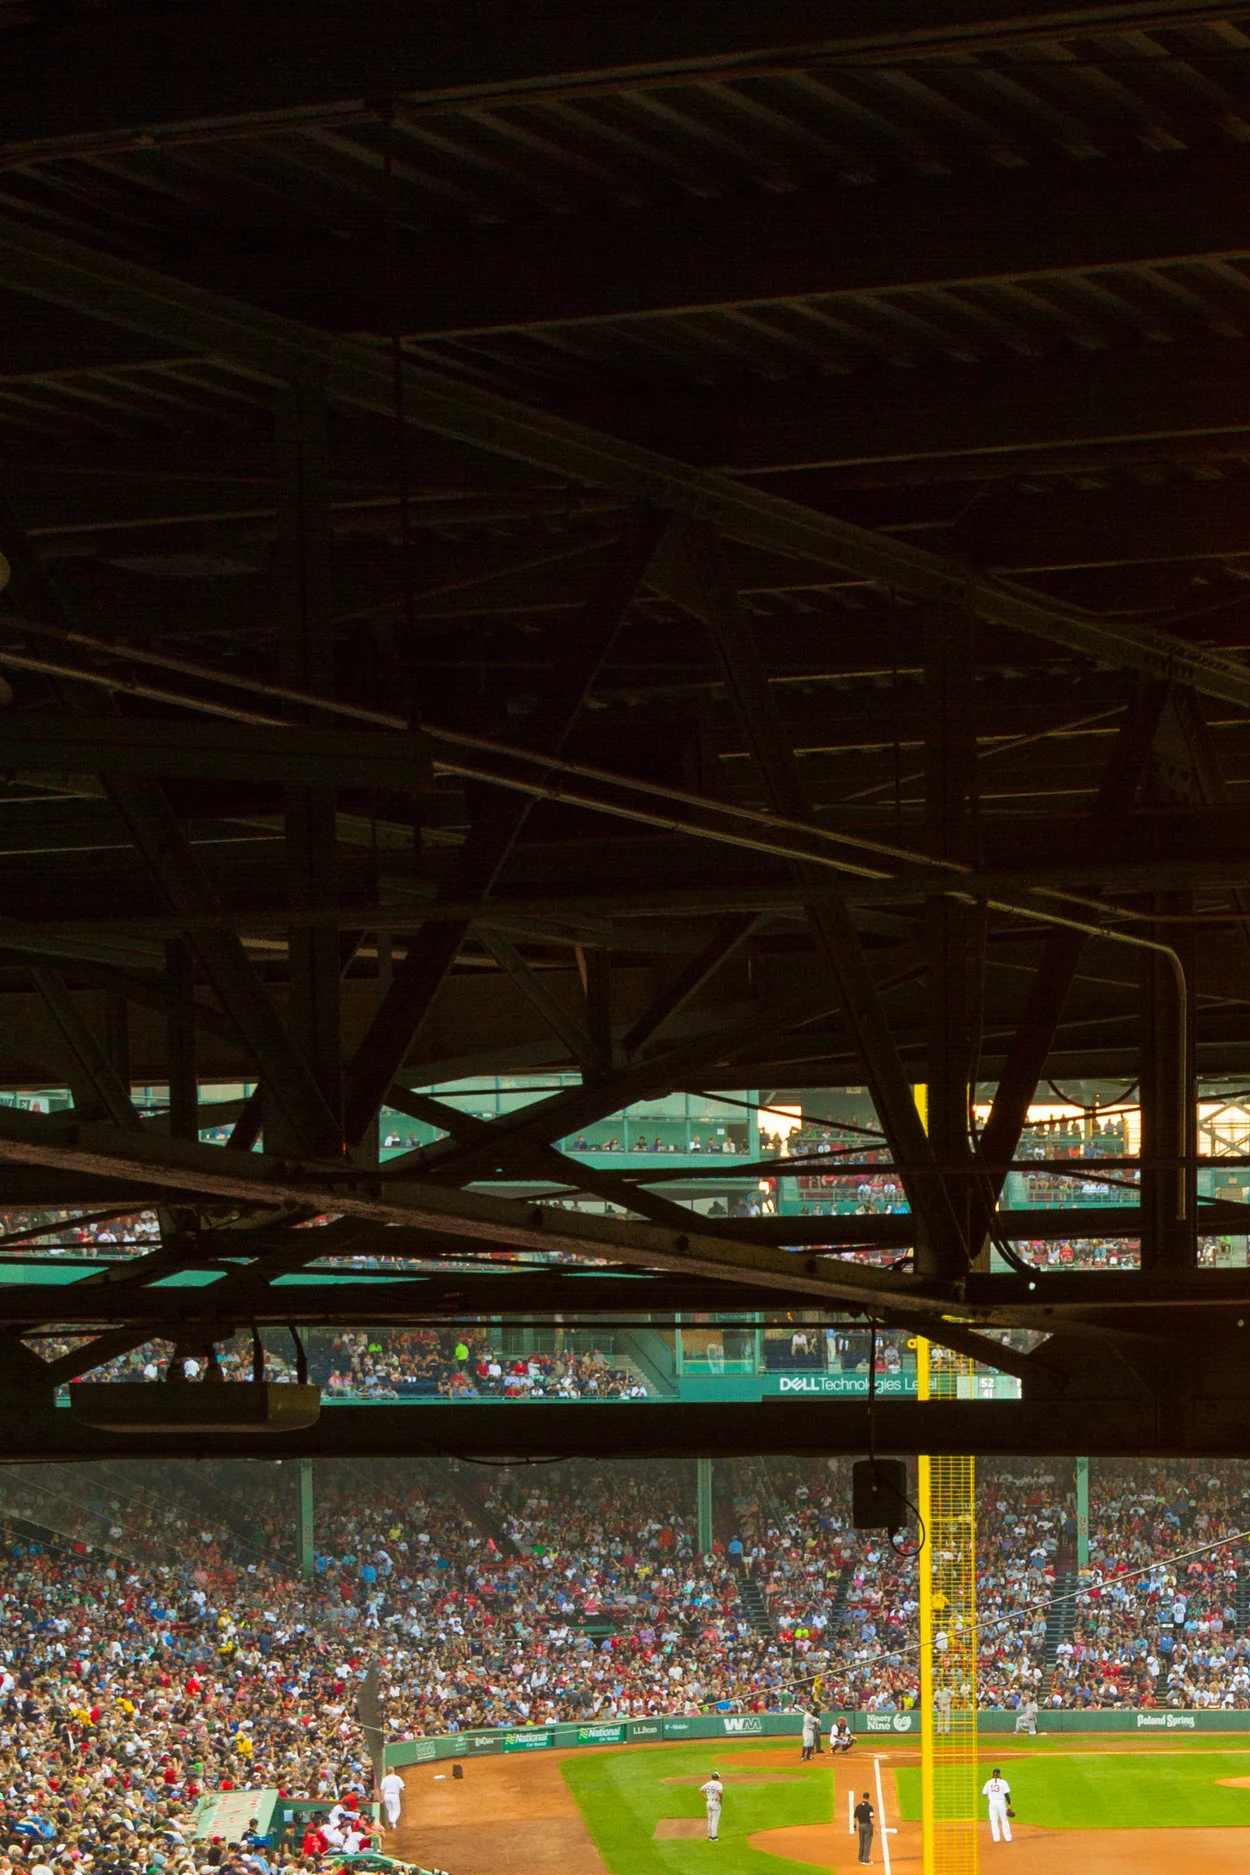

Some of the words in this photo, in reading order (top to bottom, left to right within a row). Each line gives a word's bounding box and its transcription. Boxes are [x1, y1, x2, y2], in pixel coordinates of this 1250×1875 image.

[779, 1377, 820, 1391] DELL
[819, 1377, 901, 1394] Technolgies
[904, 1378, 937, 1391] Leel
[724, 1717, 763, 1731] WM
[867, 1714, 892, 1724] Ninety
[1137, 1714, 1166, 1727] Poland
[1166, 1714, 1195, 1728] Spring
[633, 1726, 658, 1735] L.L.Bean
[867, 1722, 890, 1731] Nine
[515, 1732, 549, 1743] National
[588, 1727, 621, 1738] National
